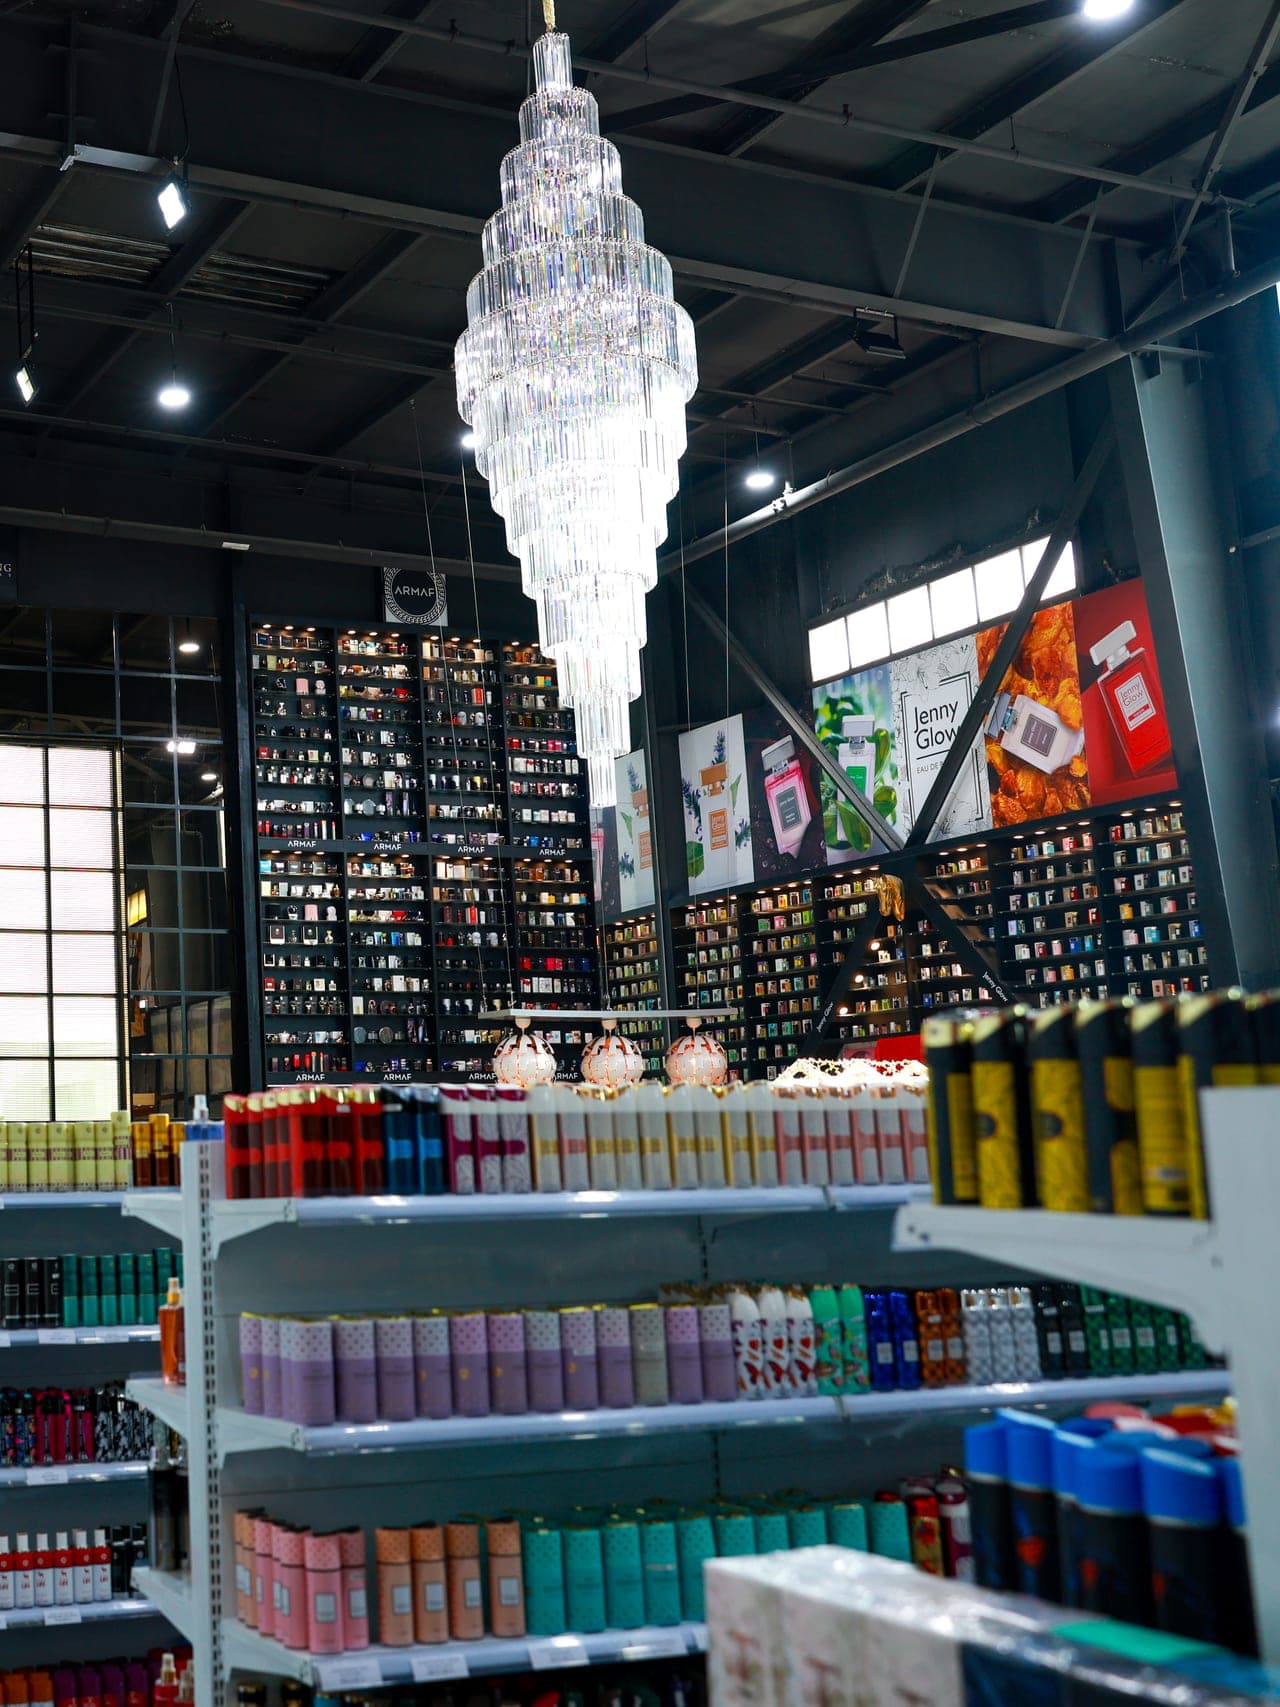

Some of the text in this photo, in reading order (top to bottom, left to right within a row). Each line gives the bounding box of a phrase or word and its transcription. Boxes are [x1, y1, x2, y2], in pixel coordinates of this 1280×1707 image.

[394, 585, 435, 597] ARMAF
[913, 700, 958, 734] Jenny
[916, 726, 958, 750] Glow
[287, 840, 317, 848] ARMAF
[373, 843, 402, 851] ARMAF
[457, 846, 486, 854] ARMAF
[296, 1073, 325, 1081] ARMAF
[383, 1073, 412, 1081] ARMAF
